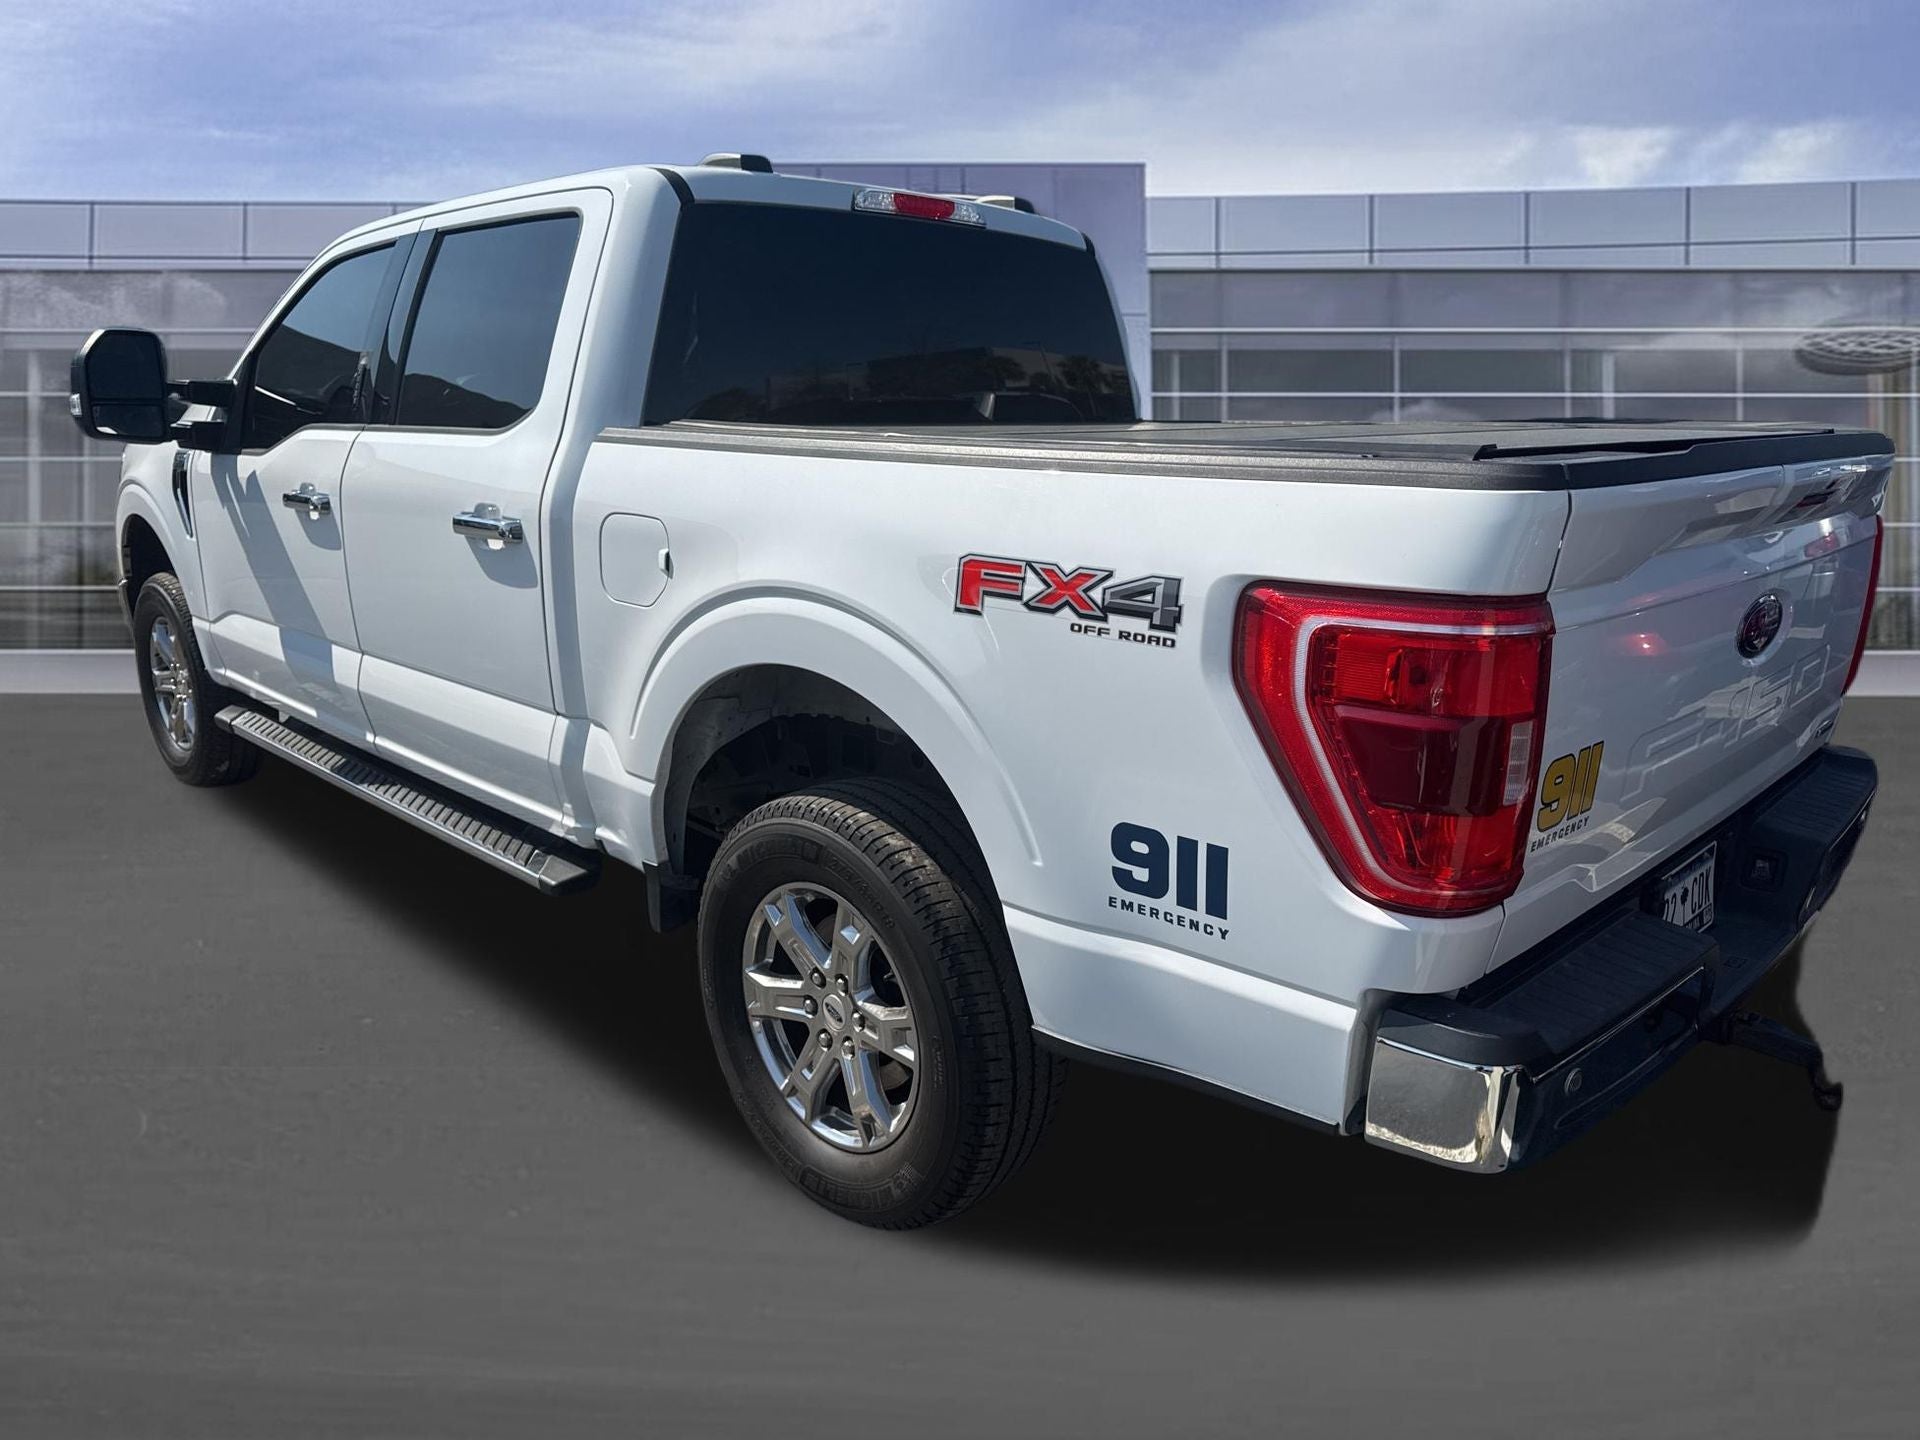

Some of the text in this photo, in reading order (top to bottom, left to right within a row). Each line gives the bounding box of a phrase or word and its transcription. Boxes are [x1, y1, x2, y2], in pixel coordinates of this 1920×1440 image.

[953, 553, 1185, 633] FX4
[1069, 622, 1176, 649] OFF ROAD
[1537, 740, 1605, 832] 911
[1530, 815, 1590, 853] EMERGENCY
[1110, 821, 1229, 921] 911
[1108, 896, 1229, 940] EMERGENCY
